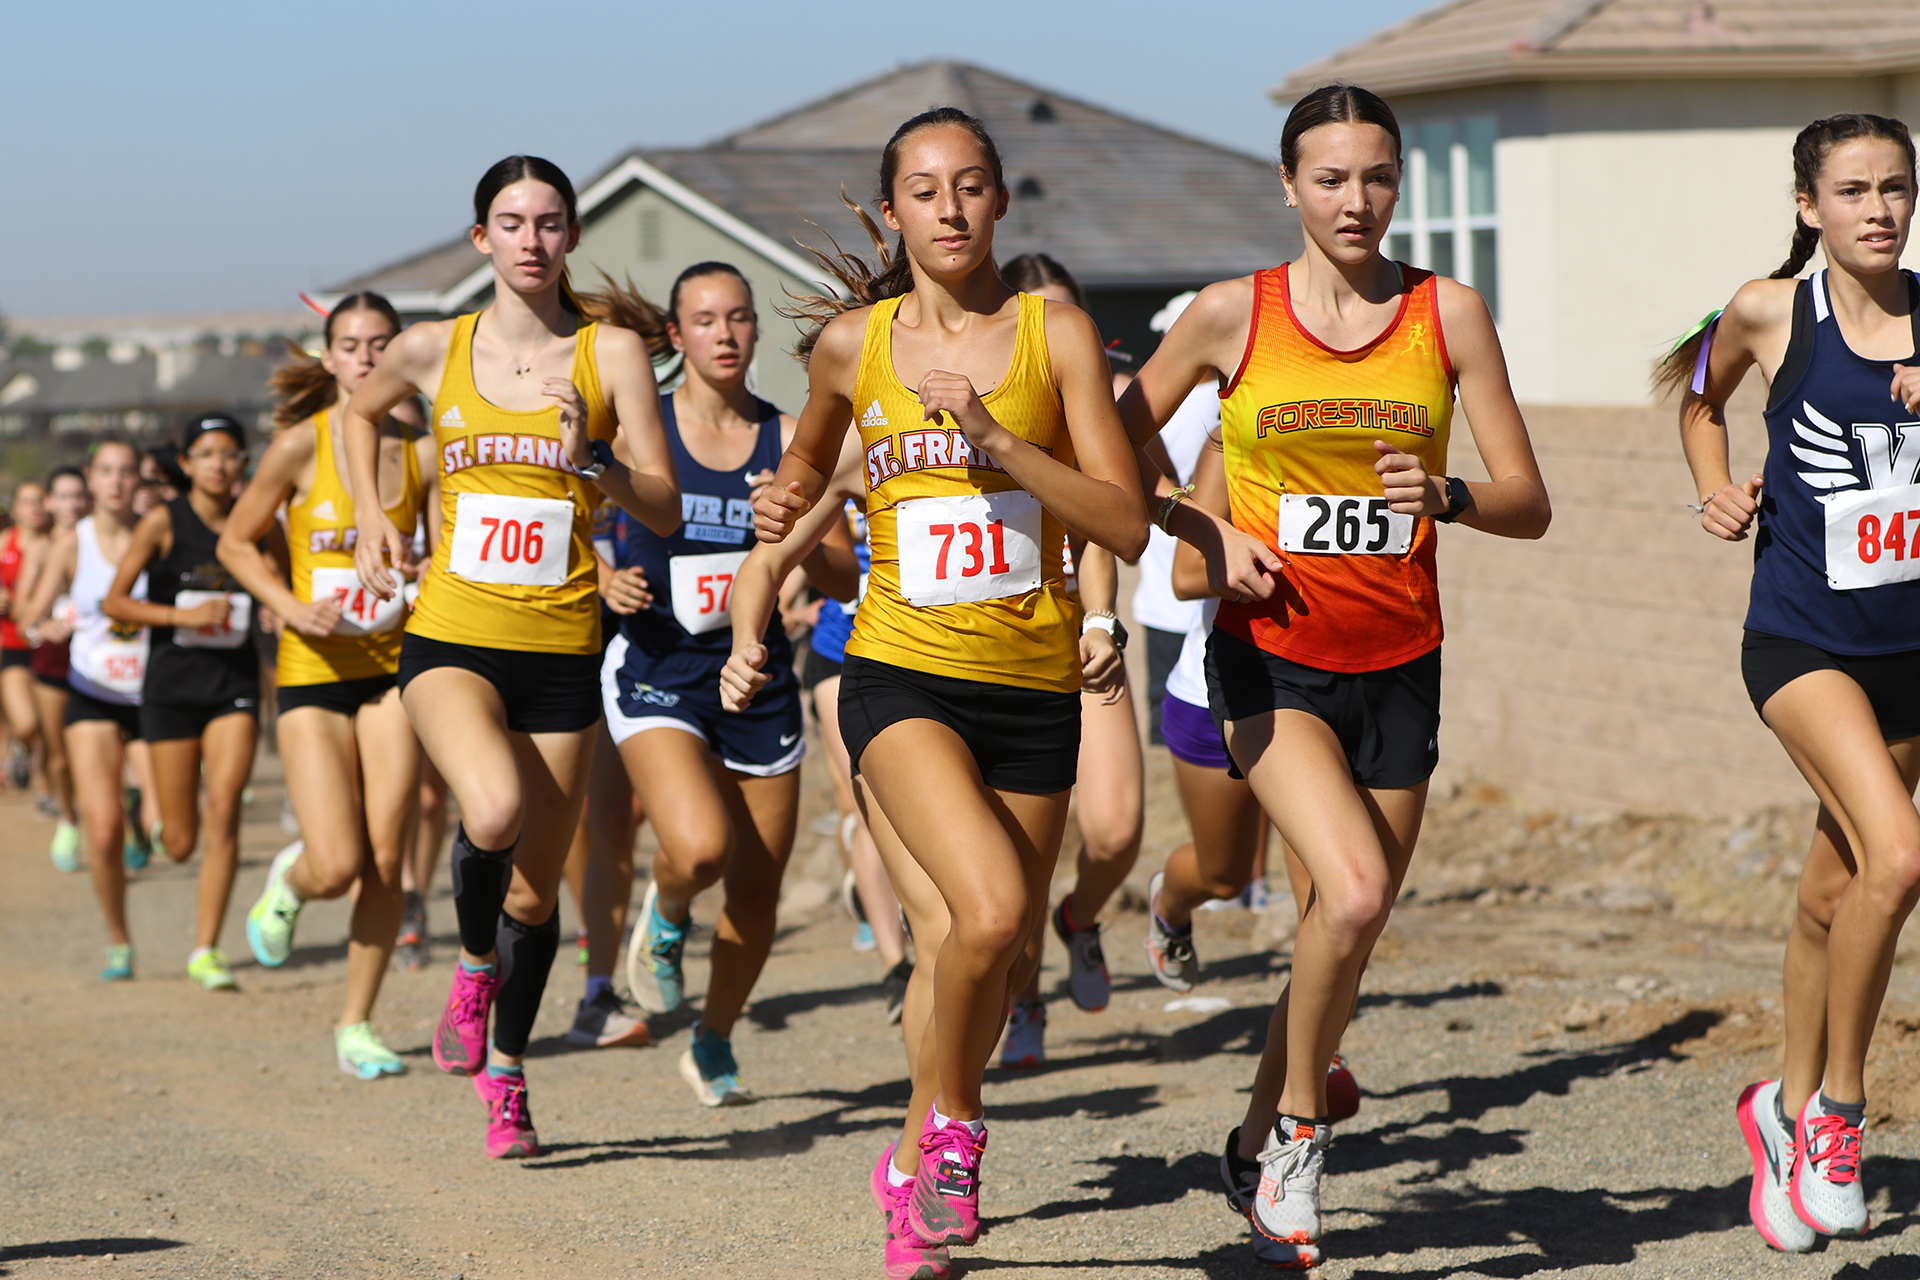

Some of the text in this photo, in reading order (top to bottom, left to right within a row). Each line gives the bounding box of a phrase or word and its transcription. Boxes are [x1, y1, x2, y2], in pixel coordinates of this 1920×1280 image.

[860, 414, 889, 428] adidas
[1257, 398, 1435, 440] FORESTHILL
[474, 432, 580, 475] FRANC
[900, 428, 1051, 473] FRAN
[680, 492, 723, 526] VER
[1302, 495, 1391, 553] 265
[479, 516, 544, 565] 706
[928, 518, 1011, 581] 731
[1856, 508, 1920, 566] 847
[696, 572, 735, 615] 57
